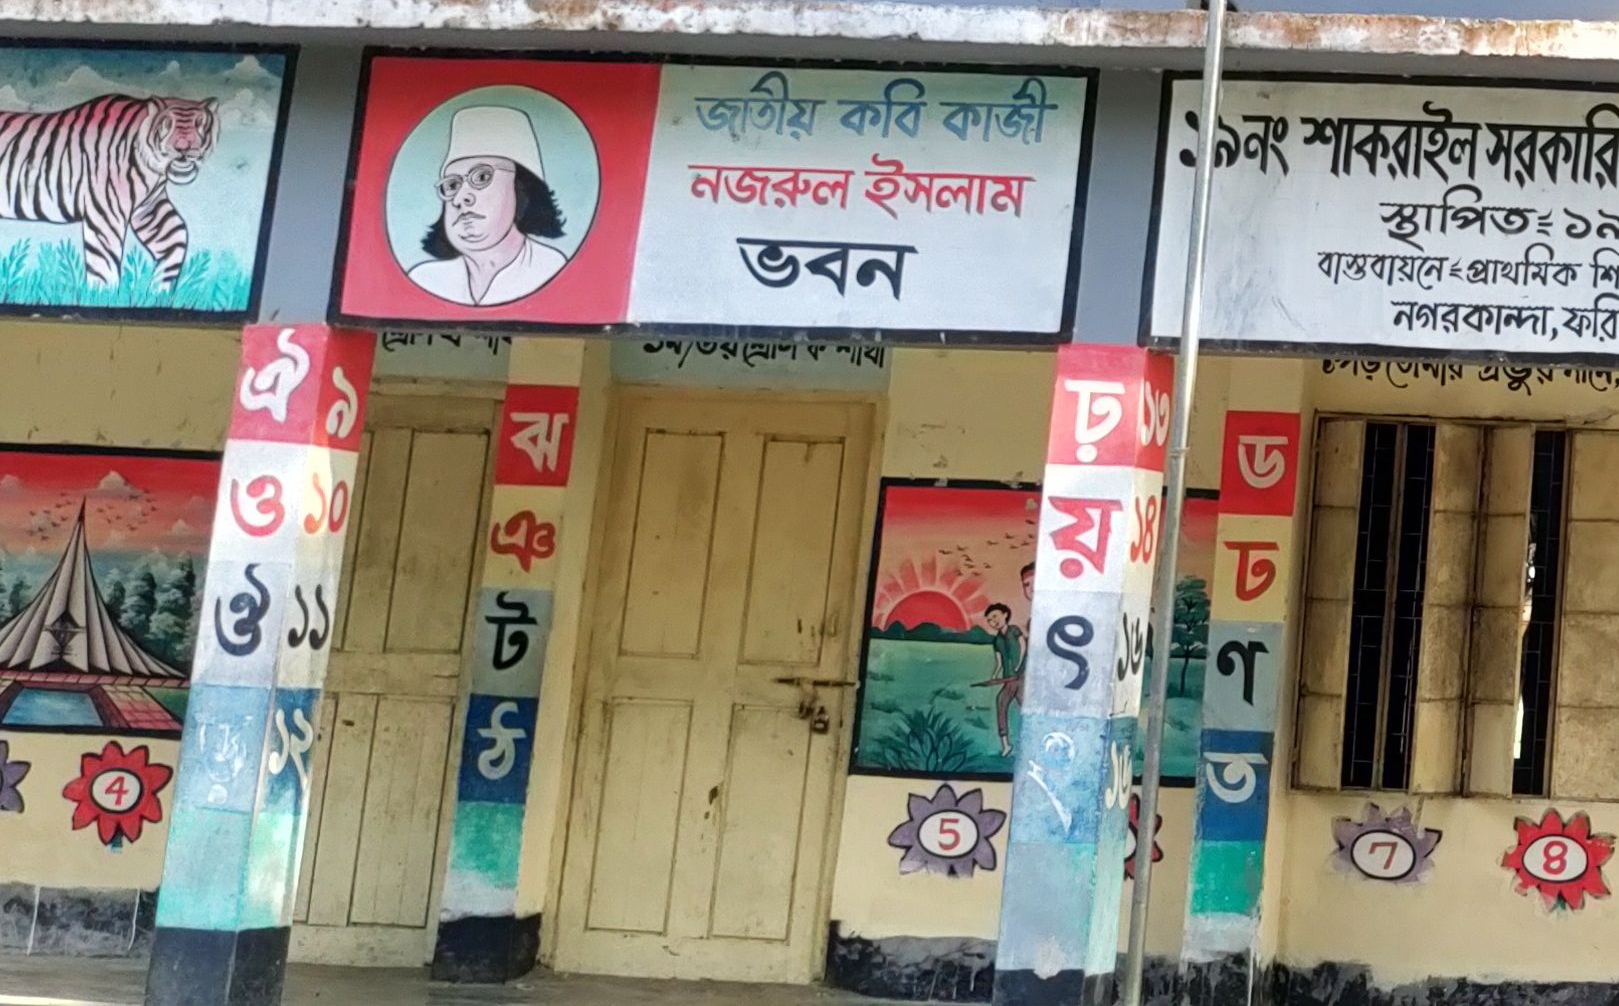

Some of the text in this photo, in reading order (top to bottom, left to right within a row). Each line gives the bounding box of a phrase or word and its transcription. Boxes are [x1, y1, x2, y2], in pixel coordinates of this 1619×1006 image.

[695, 70, 1058, 144] জাতীয় কবি কাজী
[1300, 101, 1481, 183] শাকরাইল
[688, 154, 1035, 218] নজরুল ইসলাম
[736, 237, 916, 300] ভবন
[1467, 243, 1583, 288] প্রাথমিক
[239, 328, 311, 422] ঐ
[509, 411, 570, 472] ঝ
[1238, 435, 1289, 488] ড
[229, 475, 285, 537] ও
[303, 471, 349, 534] ১০
[490, 511, 555, 573] ঞ
[1223, 541, 1280, 601] ঢ
[215, 562, 272, 657] ঔ
[287, 583, 331, 650] ১১
[485, 591, 538, 670] ট
[1216, 640, 1268, 706] ণ
[268, 708, 313, 794] ১২
[478, 701, 527, 780] ঠ
[104, 776, 130, 805] 4
[1205, 753, 1268, 804] ত
[938, 819, 961, 851] 5
[1366, 840, 1398, 871] 7
[1540, 844, 1568, 874] 8
